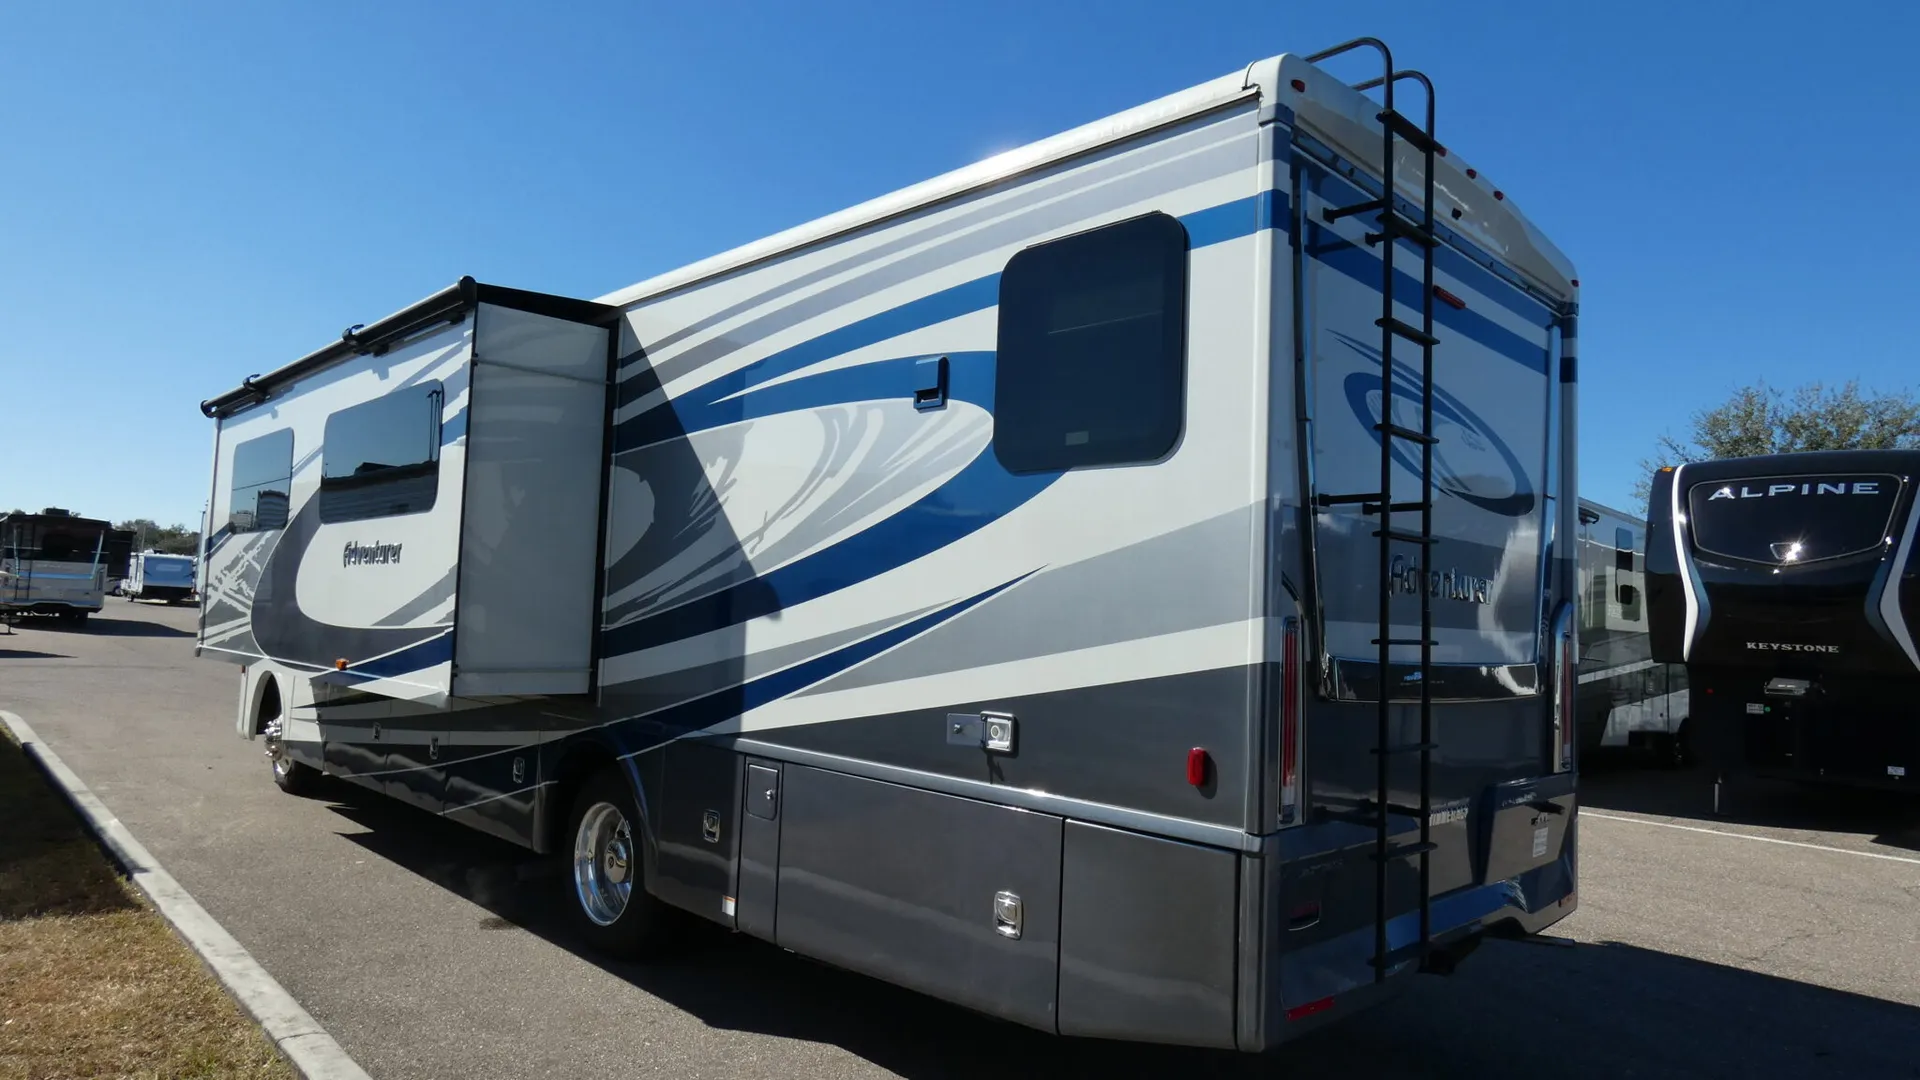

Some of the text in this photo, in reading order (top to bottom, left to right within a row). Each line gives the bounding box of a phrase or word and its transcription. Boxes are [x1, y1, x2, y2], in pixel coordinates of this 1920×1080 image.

[1707, 482, 1879, 500] ALPINE
[343, 540, 402, 568] Adventurer
[1746, 641, 1840, 653] KEYSTONE
